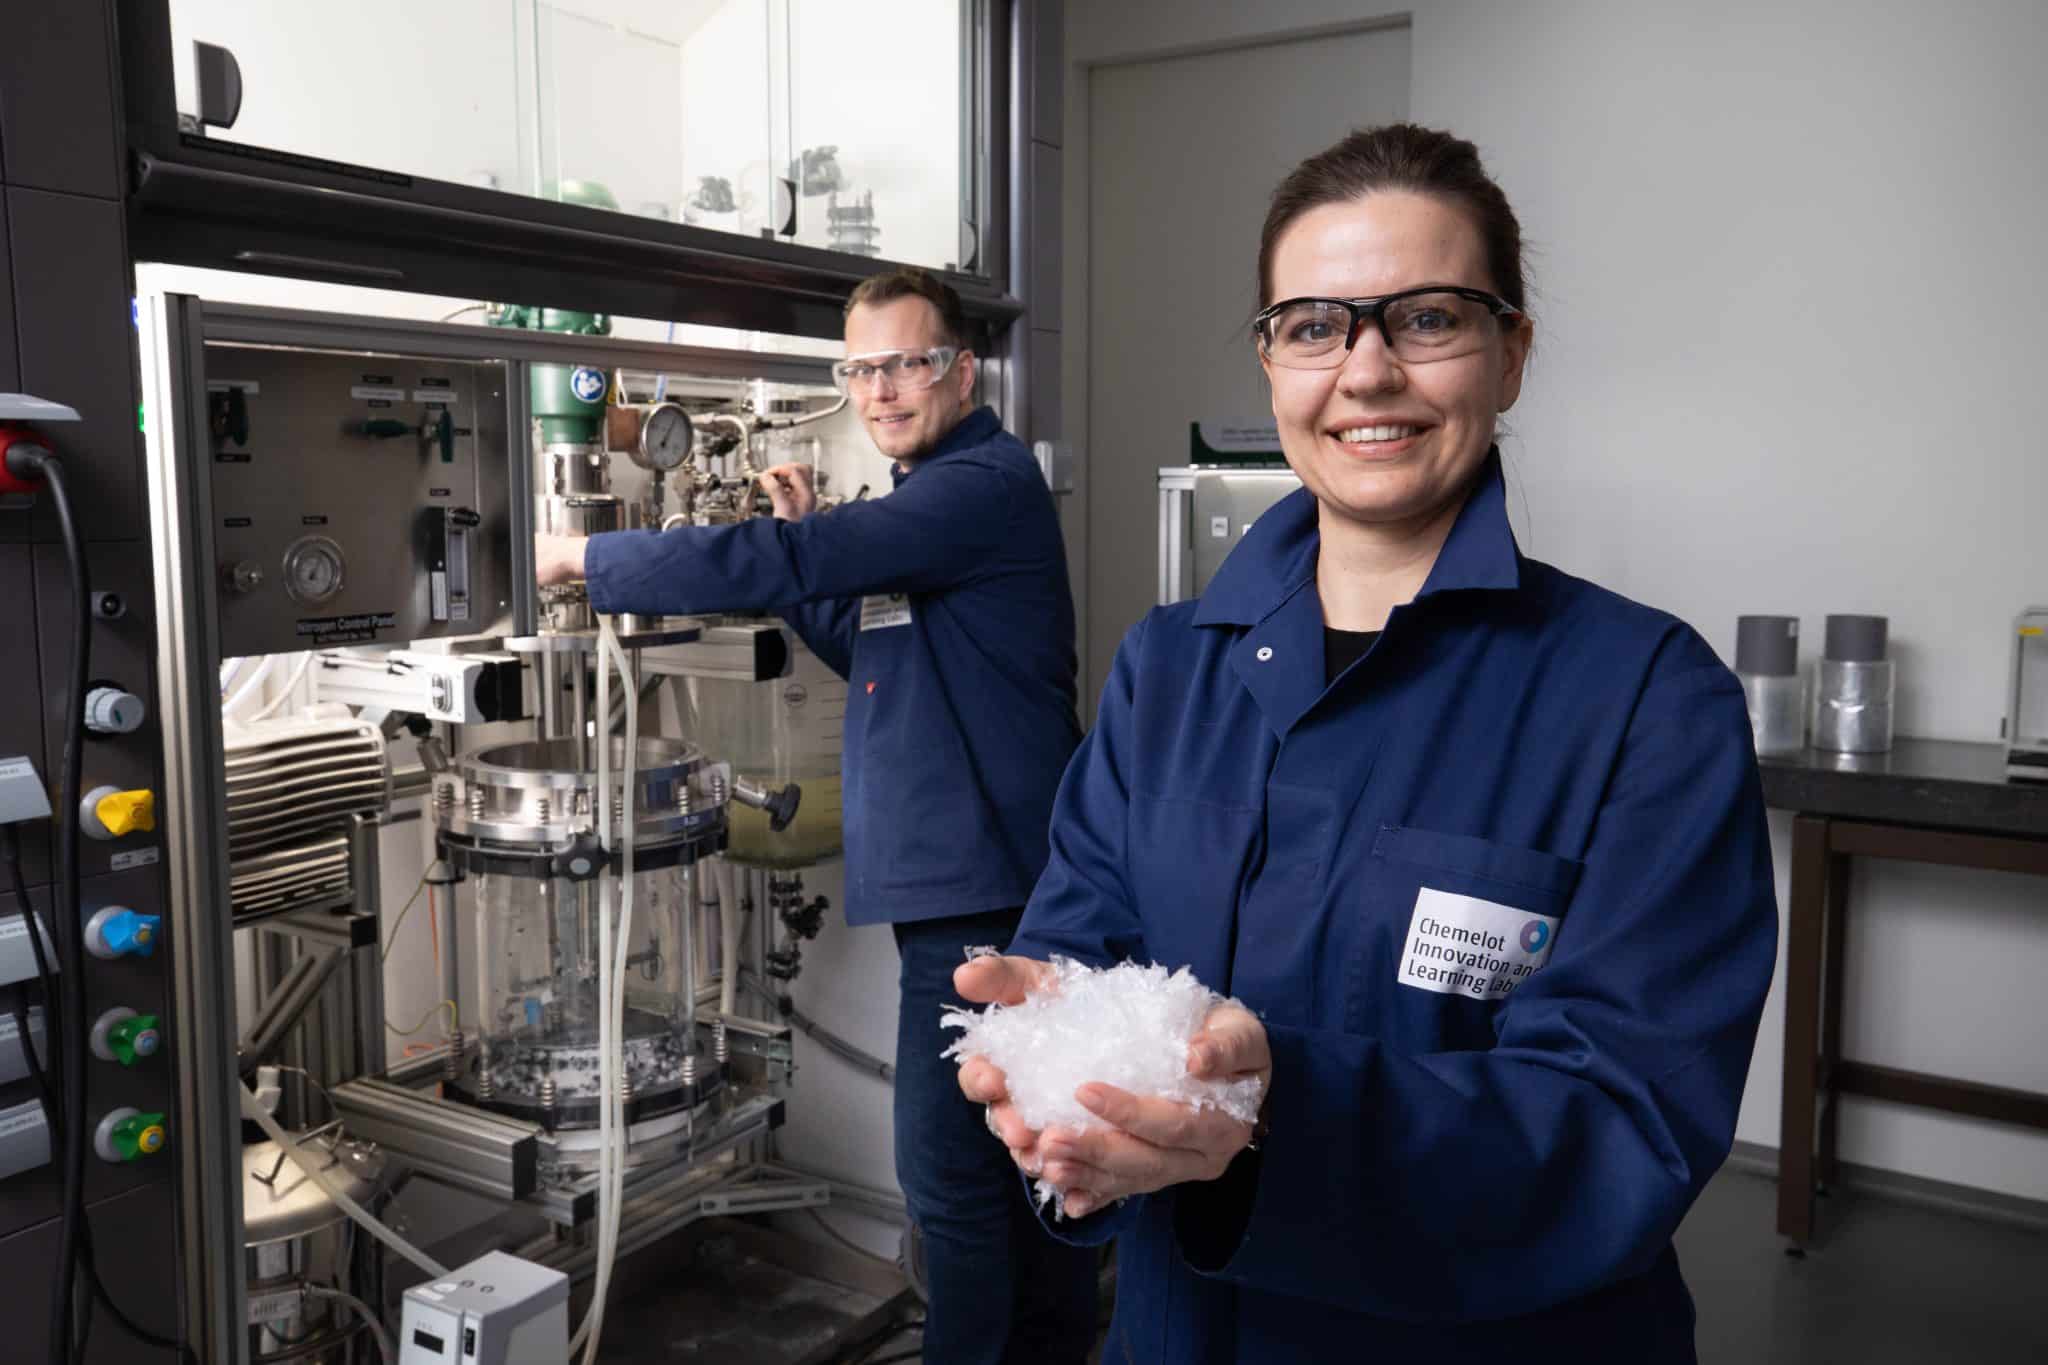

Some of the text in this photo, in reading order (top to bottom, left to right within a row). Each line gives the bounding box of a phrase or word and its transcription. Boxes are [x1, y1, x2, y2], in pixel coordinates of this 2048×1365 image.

[1419, 917, 1506, 952] Chemelot
[1412, 937, 1511, 973] Innovation
[1408, 959, 1520, 994] Learning lab
